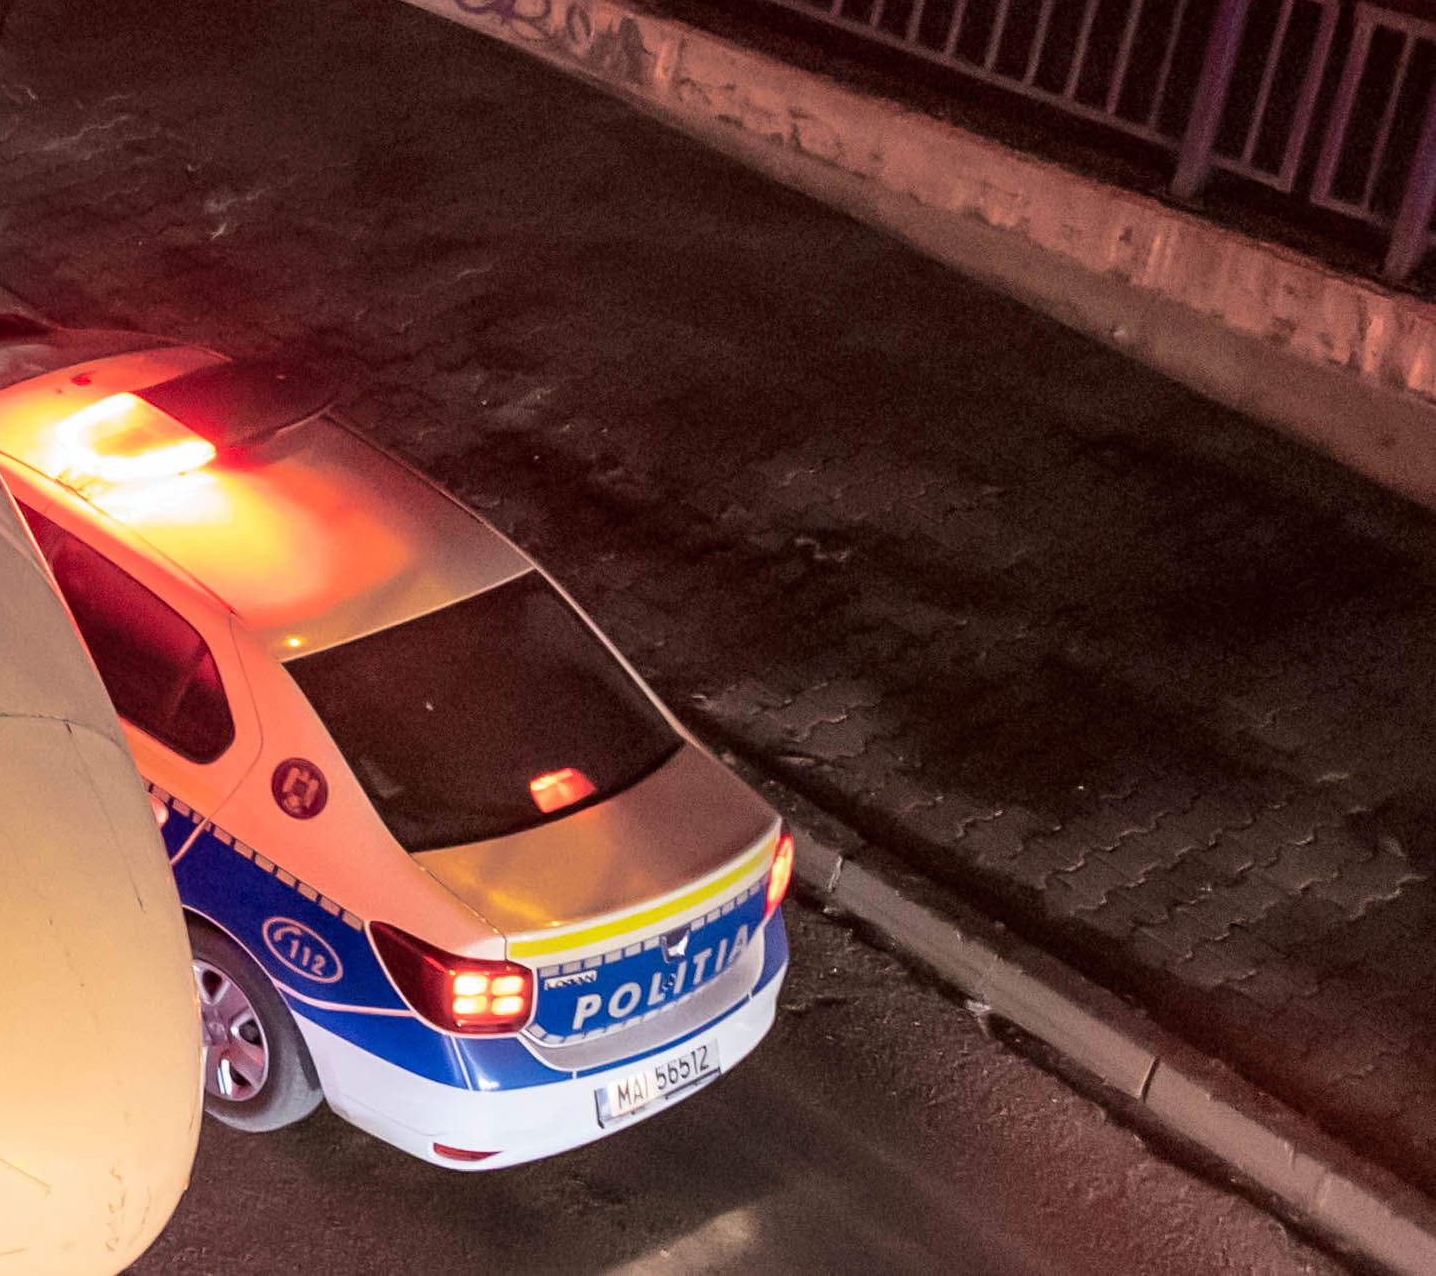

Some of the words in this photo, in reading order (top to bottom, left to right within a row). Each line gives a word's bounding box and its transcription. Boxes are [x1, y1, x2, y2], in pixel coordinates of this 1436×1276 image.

[289, 939, 326, 976] 112
[616, 1072, 649, 1110] MAI
[654, 1044, 710, 1090] 56512
